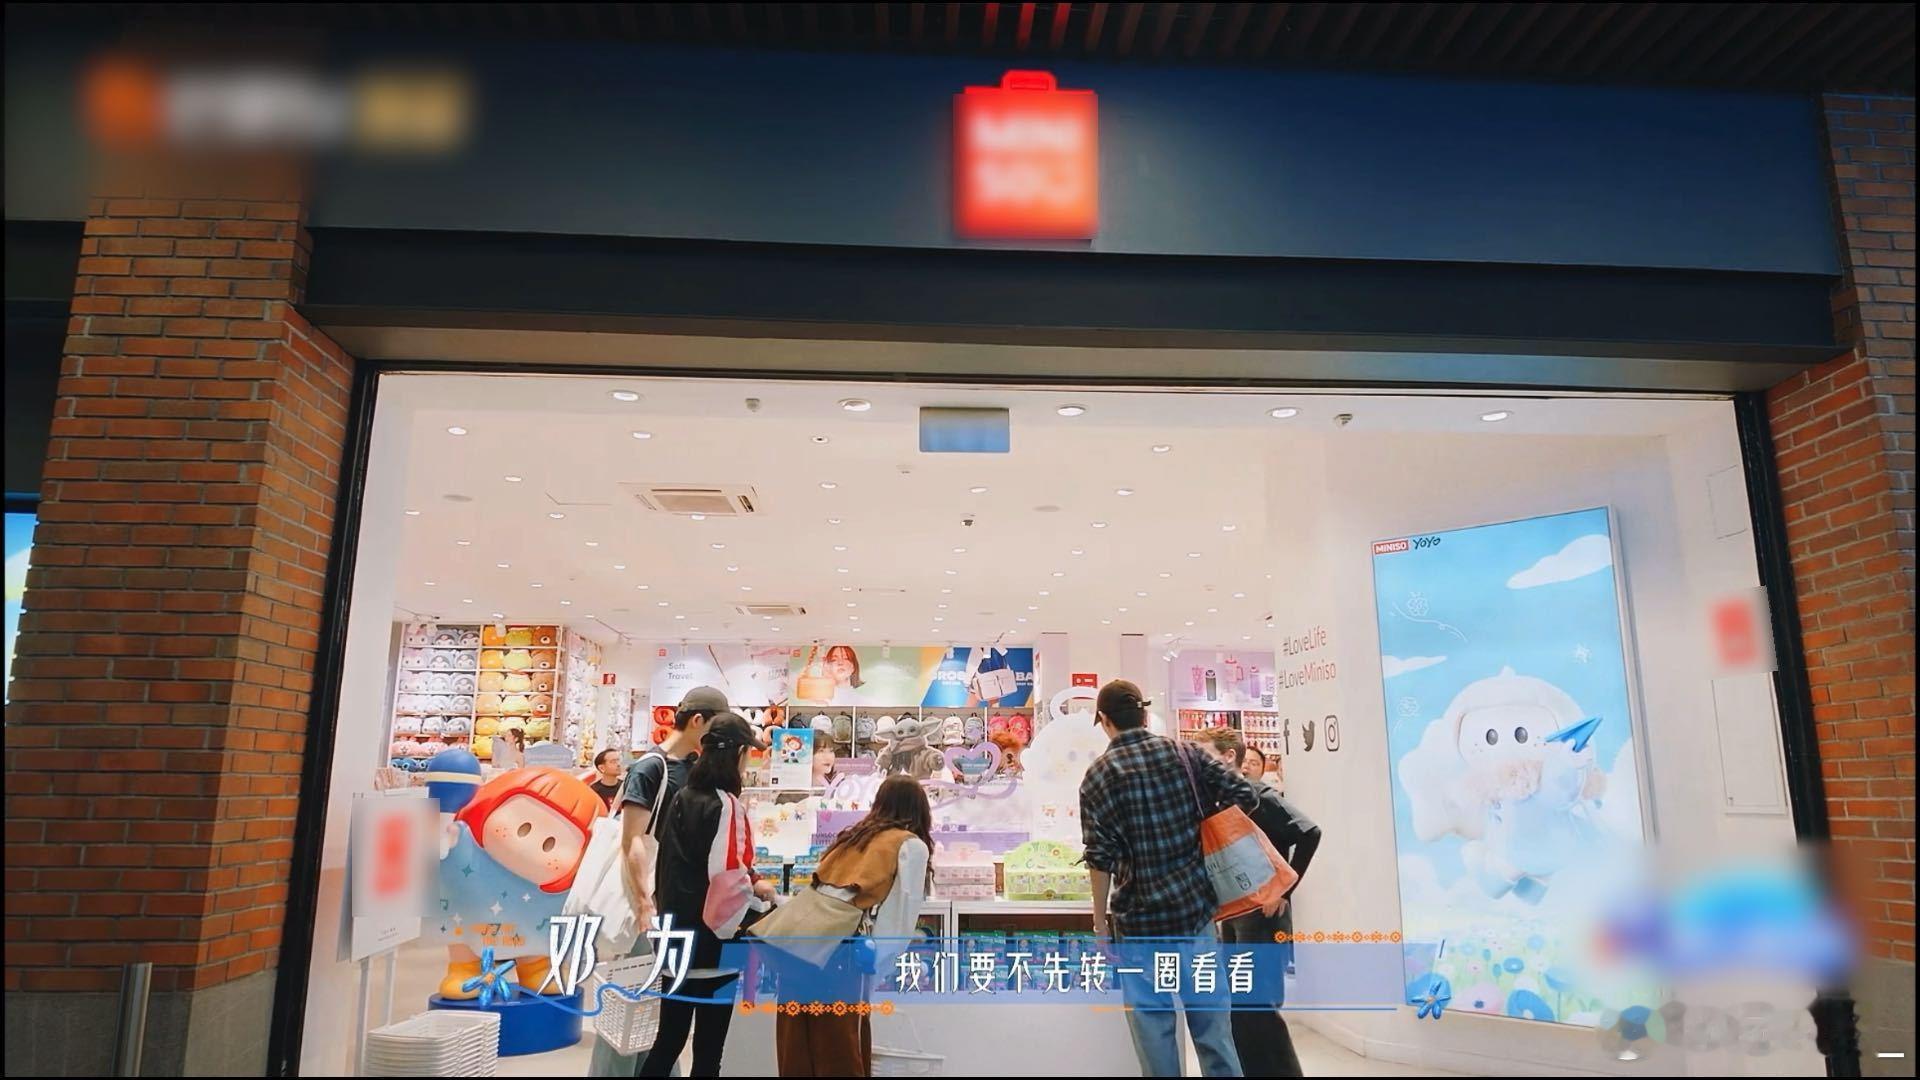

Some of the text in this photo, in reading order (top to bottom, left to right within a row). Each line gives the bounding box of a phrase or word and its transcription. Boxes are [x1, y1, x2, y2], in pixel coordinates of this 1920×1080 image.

[1375, 542, 1407, 553] MINISO
[1283, 625, 1327, 656] #LoveLife
[668, 662, 685, 670] Soft
[1279, 659, 1336, 689] #LoveMiniso
